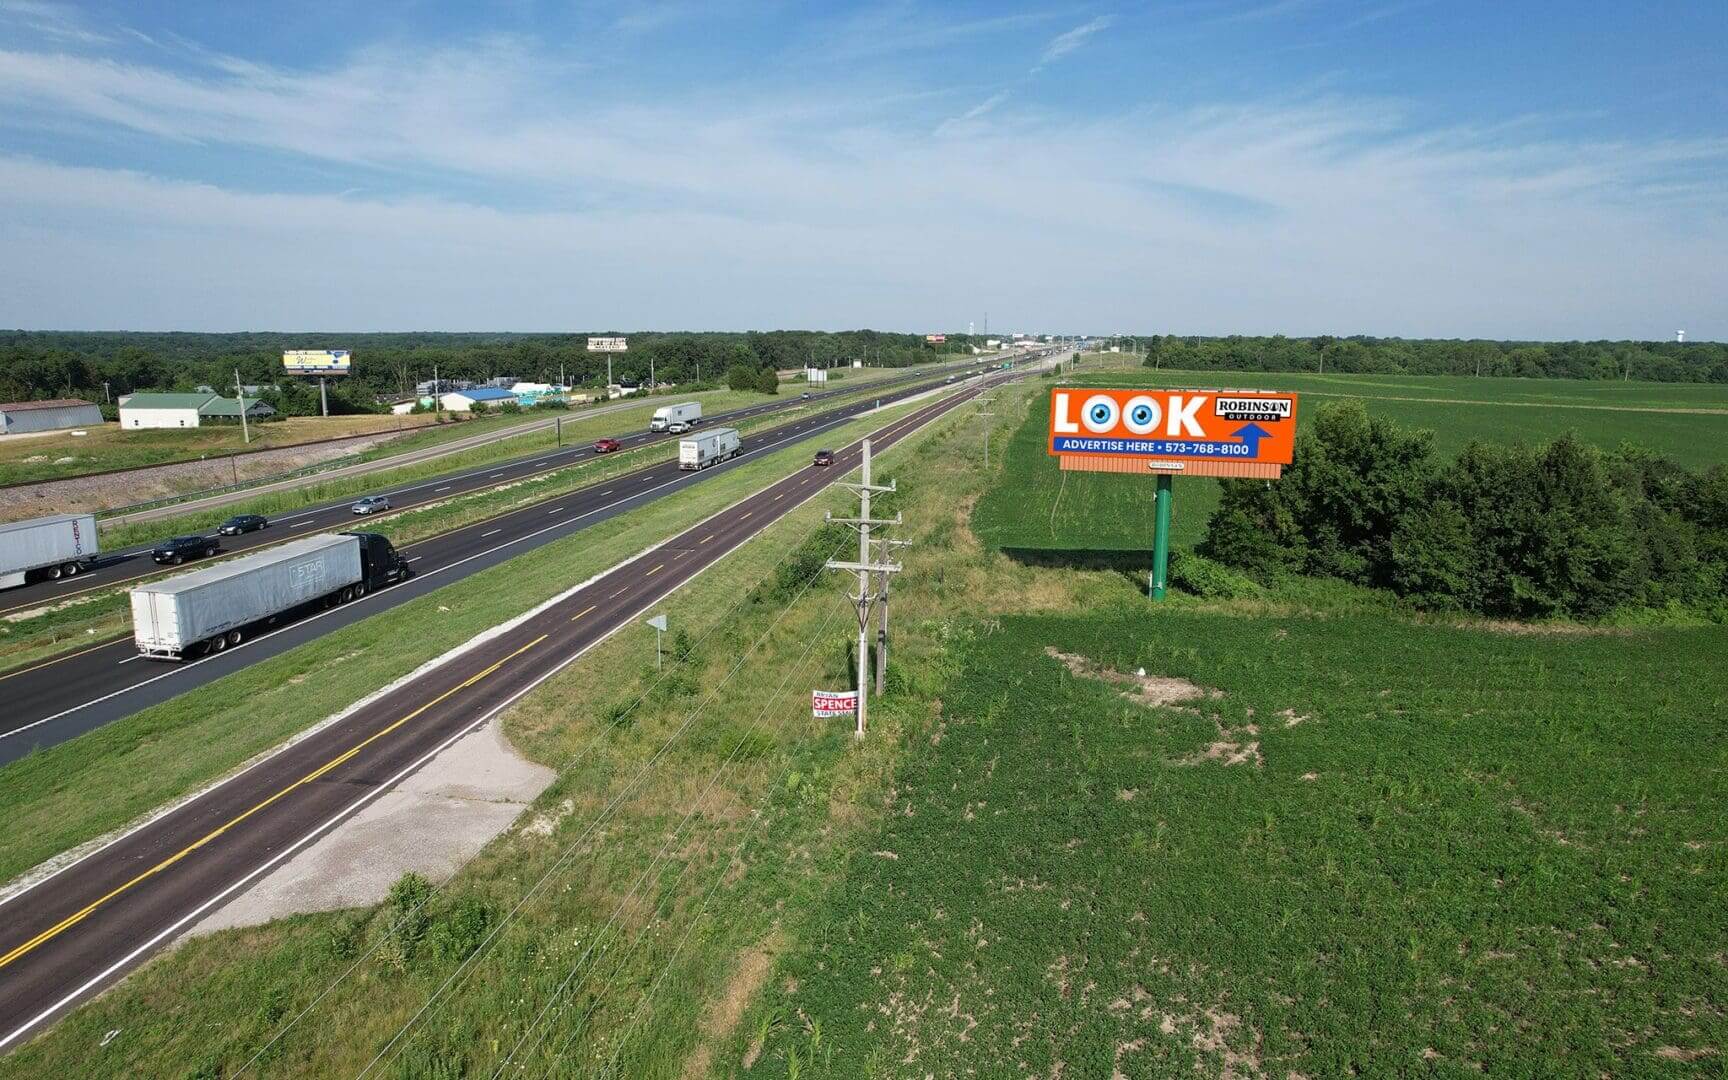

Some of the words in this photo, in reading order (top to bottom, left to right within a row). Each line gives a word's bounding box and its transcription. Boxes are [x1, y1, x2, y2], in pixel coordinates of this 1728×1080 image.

[1219, 401, 1288, 412] ROBINSON
[1054, 393, 1209, 438] LOOK
[1063, 439, 1124, 451] ADVERTISE
[1126, 442, 1154, 452] HERE
[1165, 443, 1249, 455] 573-768-8100
